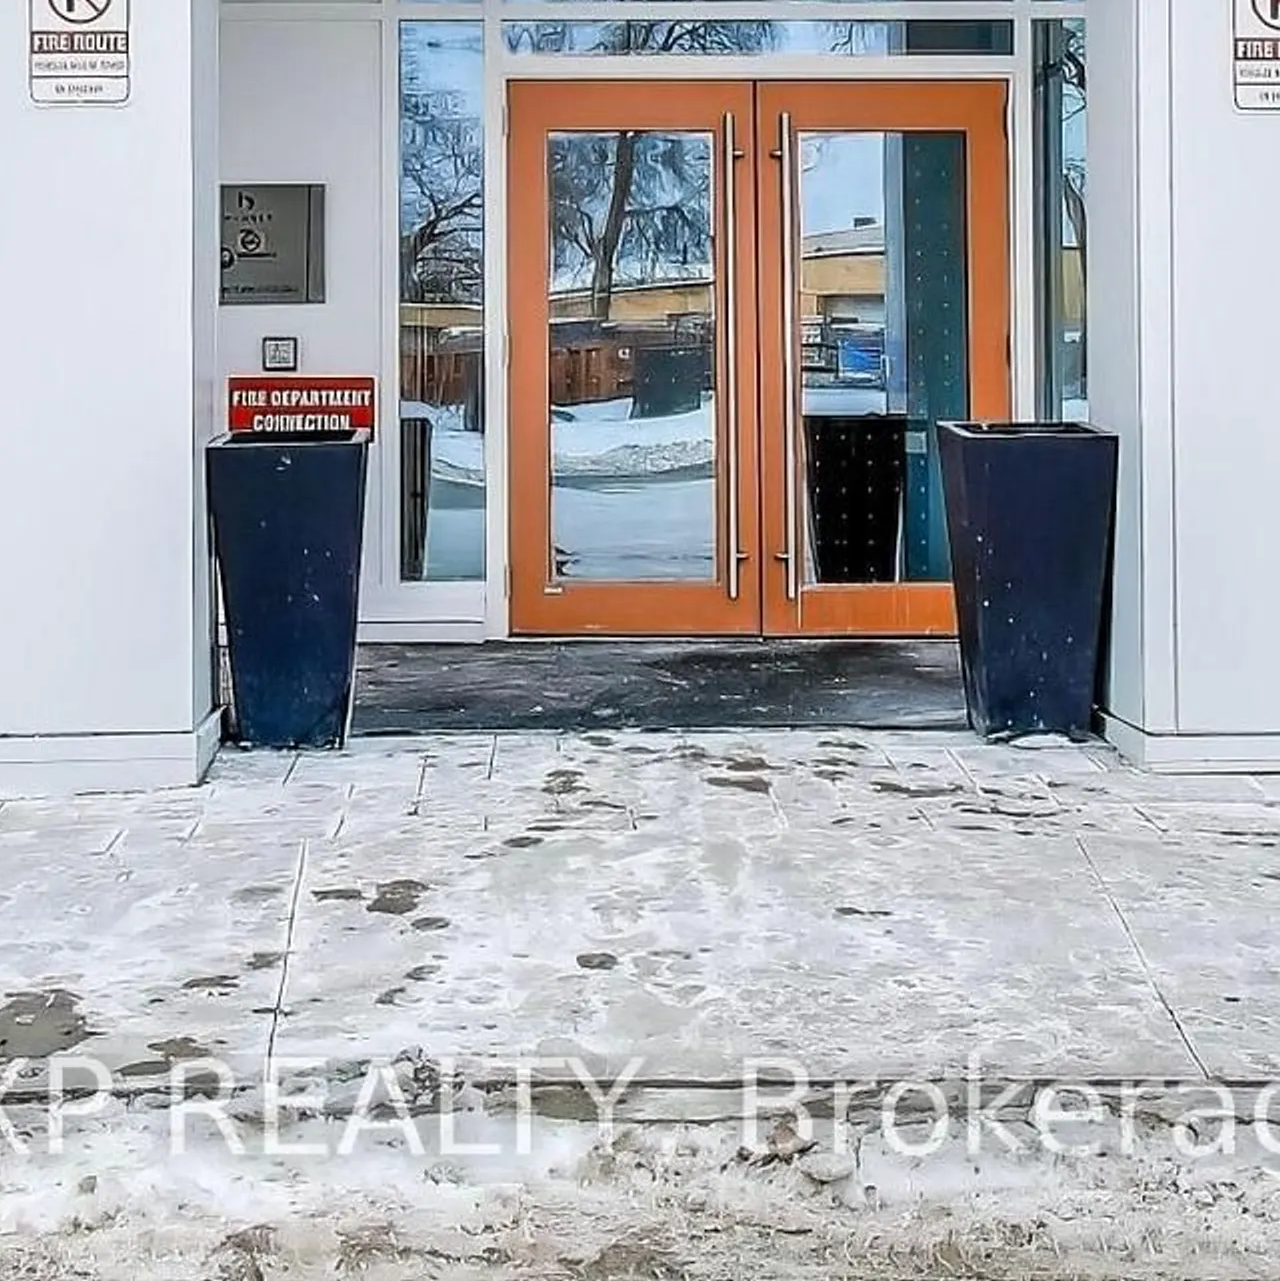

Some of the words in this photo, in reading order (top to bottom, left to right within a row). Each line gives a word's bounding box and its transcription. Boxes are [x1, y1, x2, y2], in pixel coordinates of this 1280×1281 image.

[33, 34, 71, 51] FIRE
[73, 34, 127, 51] ROUTE
[1237, 41, 1273, 58] FIRE
[232, 390, 267, 407] FIRE
[271, 390, 371, 407] DEPARTMENT
[253, 414, 350, 432] CONNECTION
